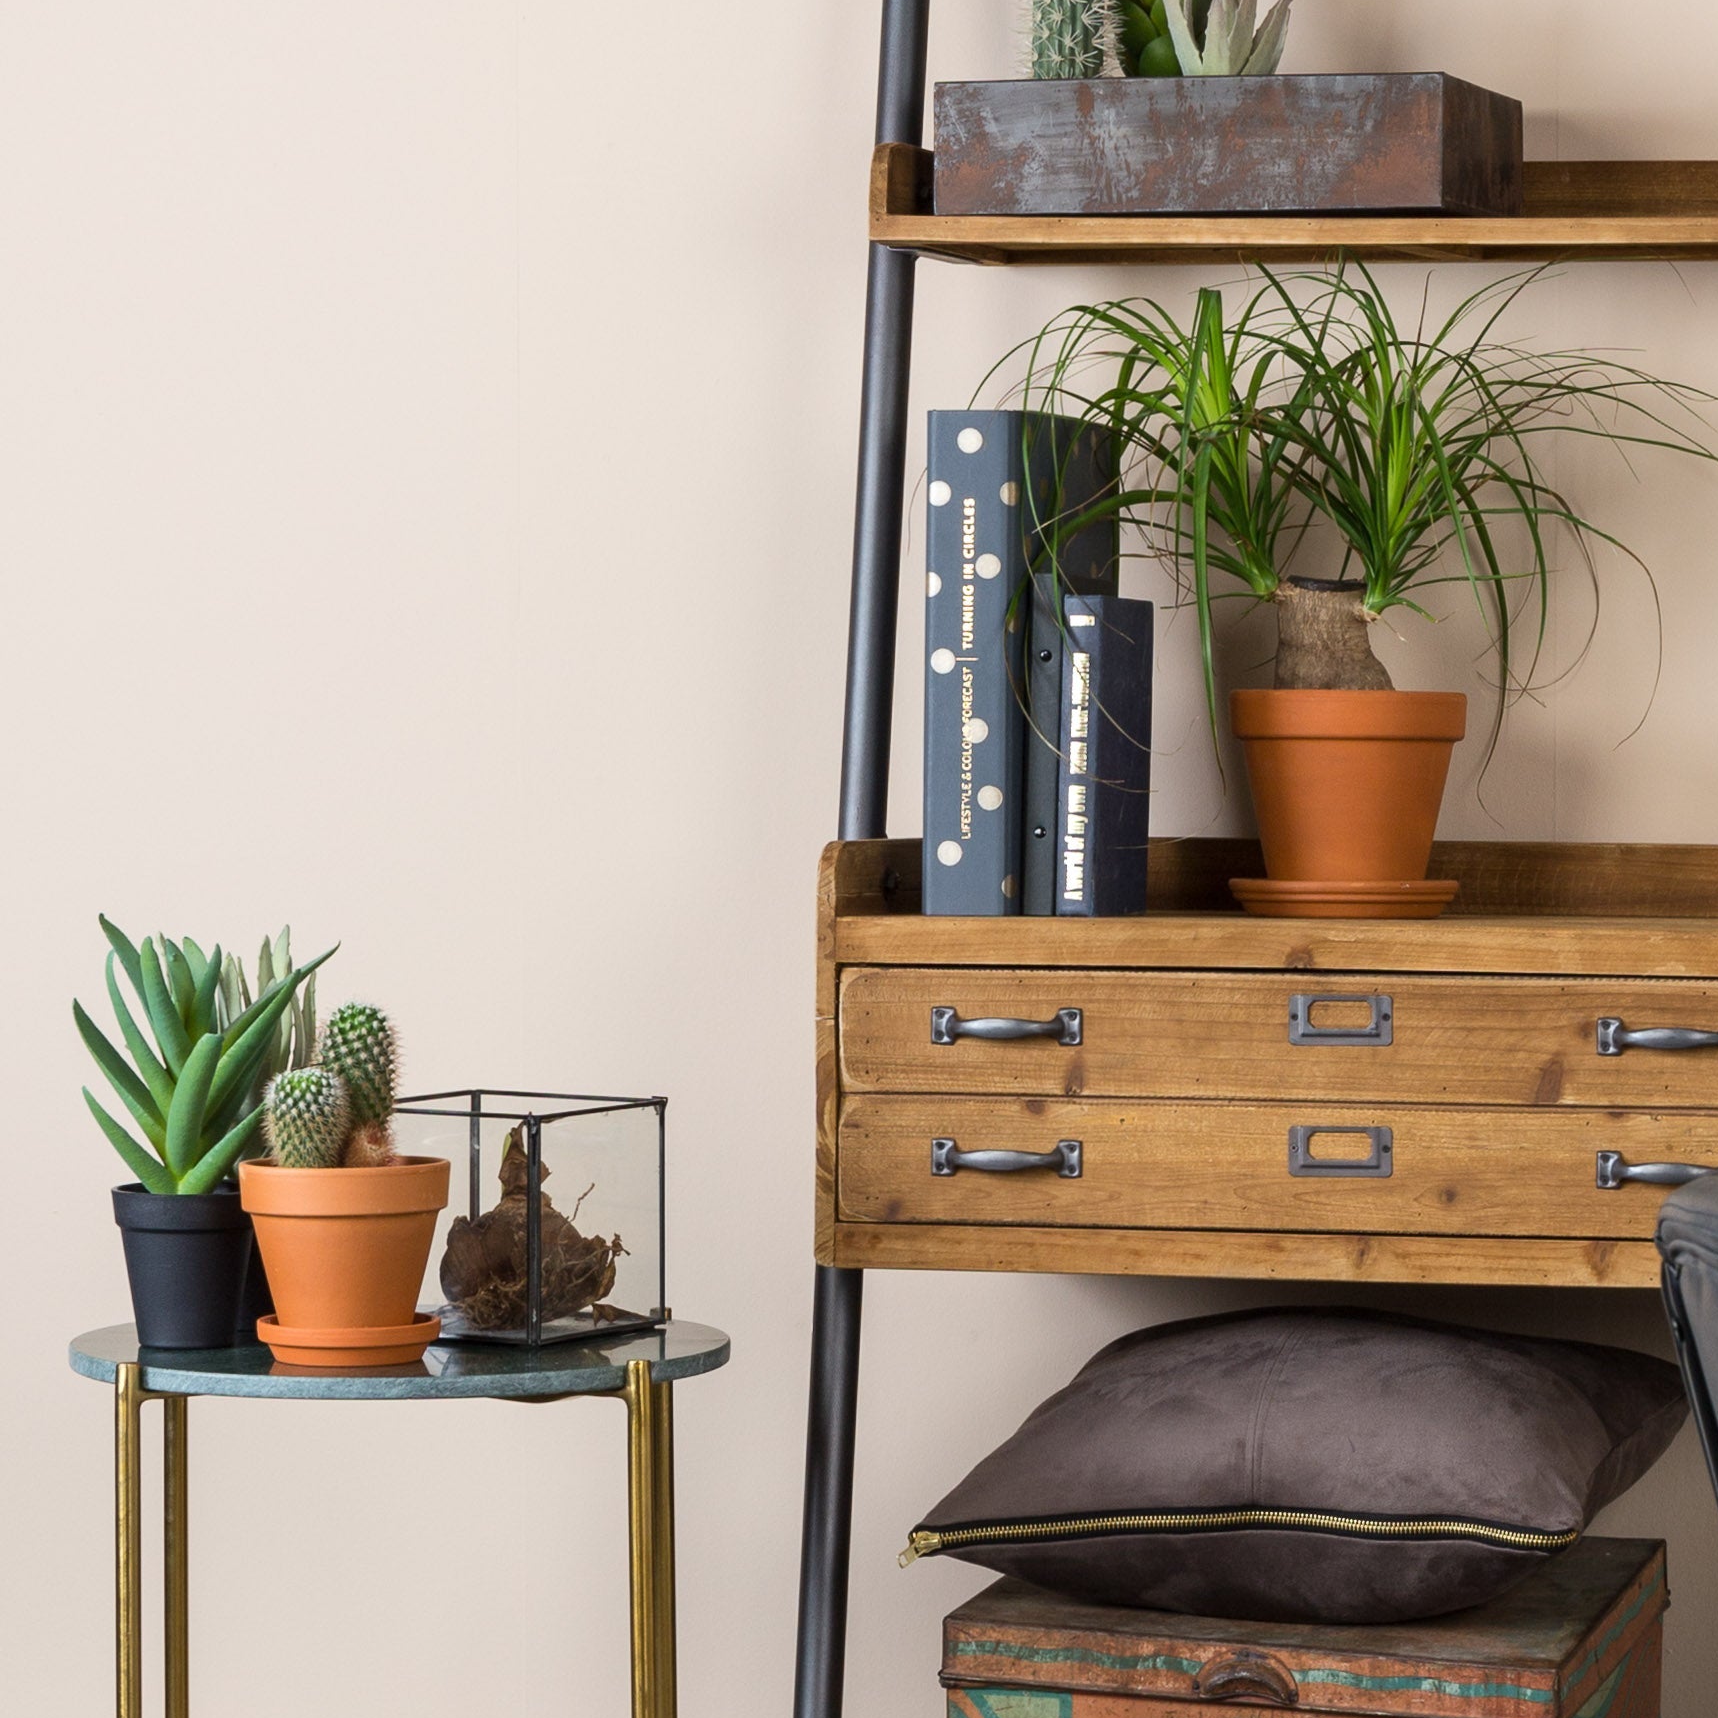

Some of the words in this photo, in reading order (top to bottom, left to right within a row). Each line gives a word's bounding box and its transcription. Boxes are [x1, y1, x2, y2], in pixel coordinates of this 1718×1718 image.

[963, 498, 975, 559] CIRCLES
[963, 563, 974, 579] IN
[962, 584, 974, 650] TURNING
[962, 667, 973, 722] FORECAST
[960, 783, 971, 839] LIFESTYLE
[1068, 784, 1087, 813] own
[1067, 814, 1089, 834] my
[1064, 835, 1085, 850] of
[1064, 851, 1085, 891] world
[1064, 891, 1083, 901] A
